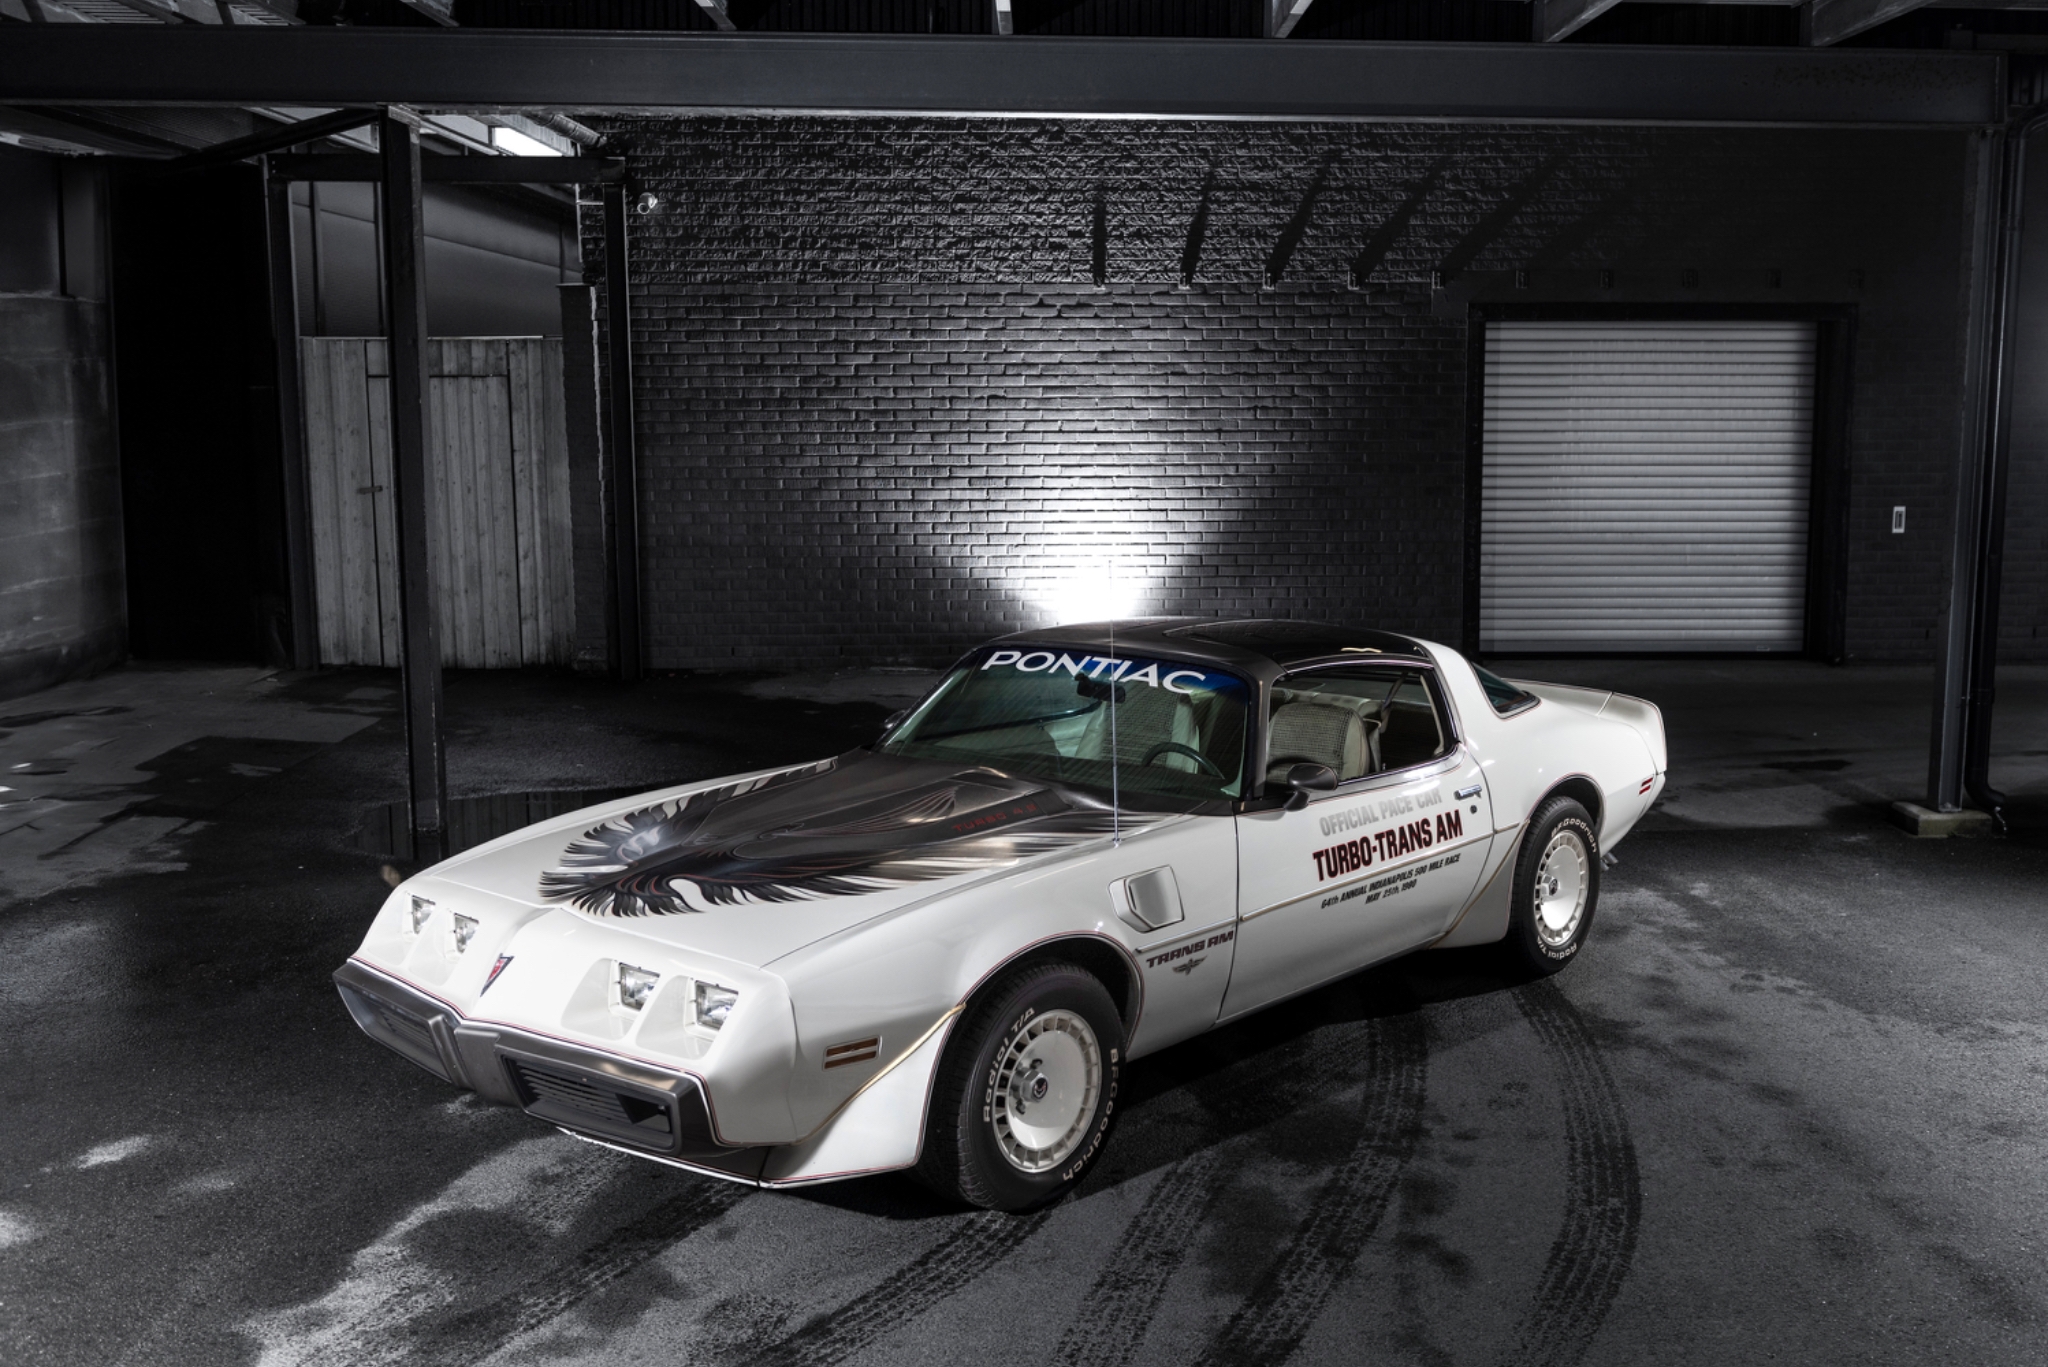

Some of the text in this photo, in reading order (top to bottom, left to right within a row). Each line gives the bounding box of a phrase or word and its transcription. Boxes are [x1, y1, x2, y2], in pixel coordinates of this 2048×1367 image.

[981, 651, 1206, 694] PONTIAC
[952, 811, 1007, 832] TURBO
[1319, 787, 1442, 837] OFFICIAL PACE CAR
[1312, 809, 1463, 882] TURBO-TRANS AM
[1340, 884, 1367, 903] ANNUAL
[1365, 868, 1414, 894] INDIANAPOLIS
[1414, 864, 1428, 877] 500
[1428, 859, 1444, 873] MILE
[1444, 853, 1461, 867] RACE
[1364, 892, 1382, 905] MAY
[1146, 930, 1234, 969] TRANS AM
[983, 1007, 1036, 1123] Radial T/A
